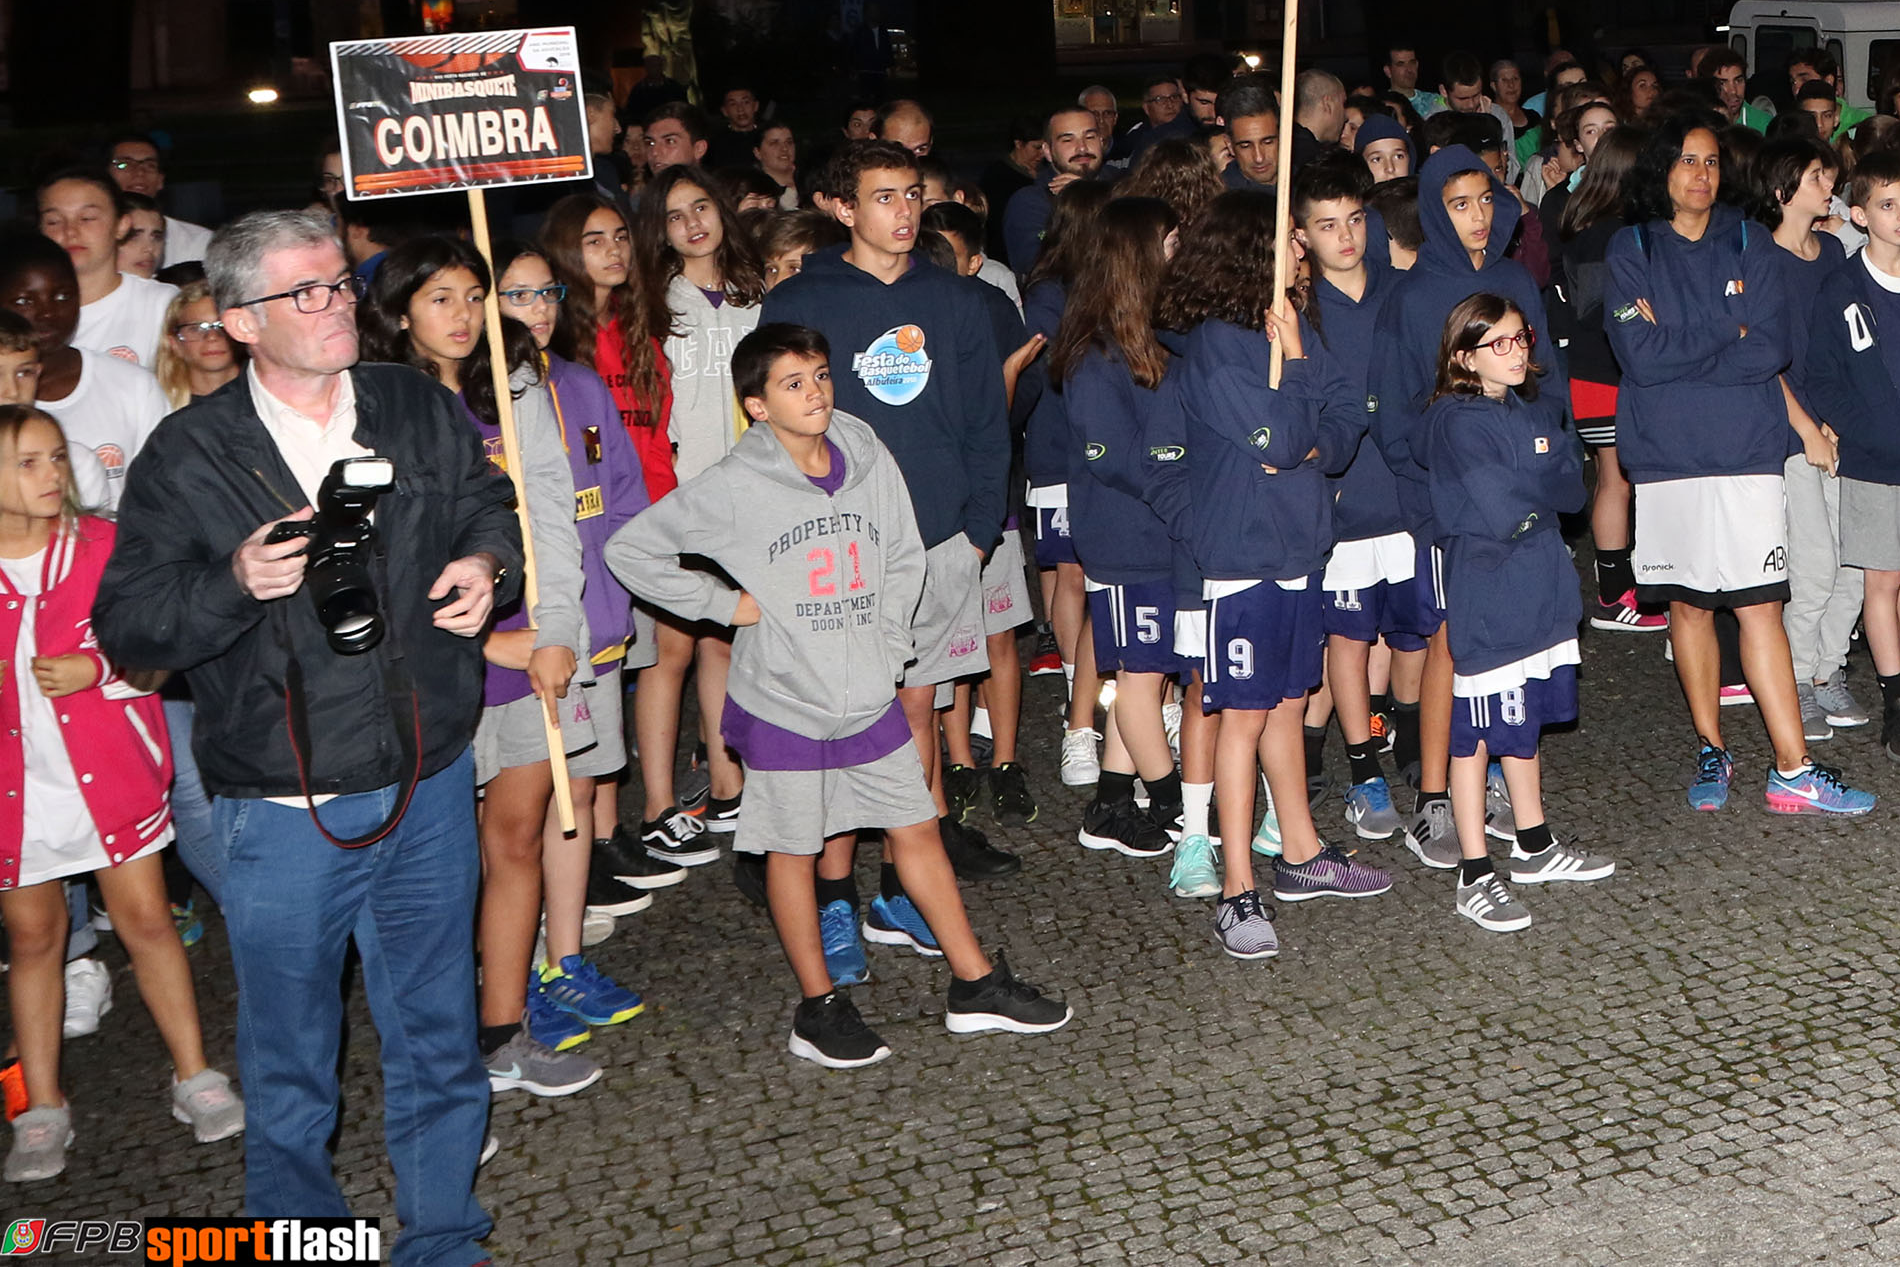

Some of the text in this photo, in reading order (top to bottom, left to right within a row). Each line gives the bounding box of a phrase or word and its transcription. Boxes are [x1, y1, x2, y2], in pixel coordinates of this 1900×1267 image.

[409, 73, 517, 104] MINIBASQUETE
[374, 106, 559, 165] COIMBRA
[669, 326, 760, 379] GA
[852, 352, 910, 371] Festa do
[859, 360, 931, 377] Basquetebol
[866, 377, 903, 386] Albufeira
[768, 513, 862, 564] PROPERTY
[1051, 507, 1069, 537] 4
[807, 541, 866, 597] 21
[857, 612, 873, 626] INC
[1136, 607, 1160, 643] 5
[1228, 638, 1254, 679] 9
[1500, 687, 1525, 726] 8
